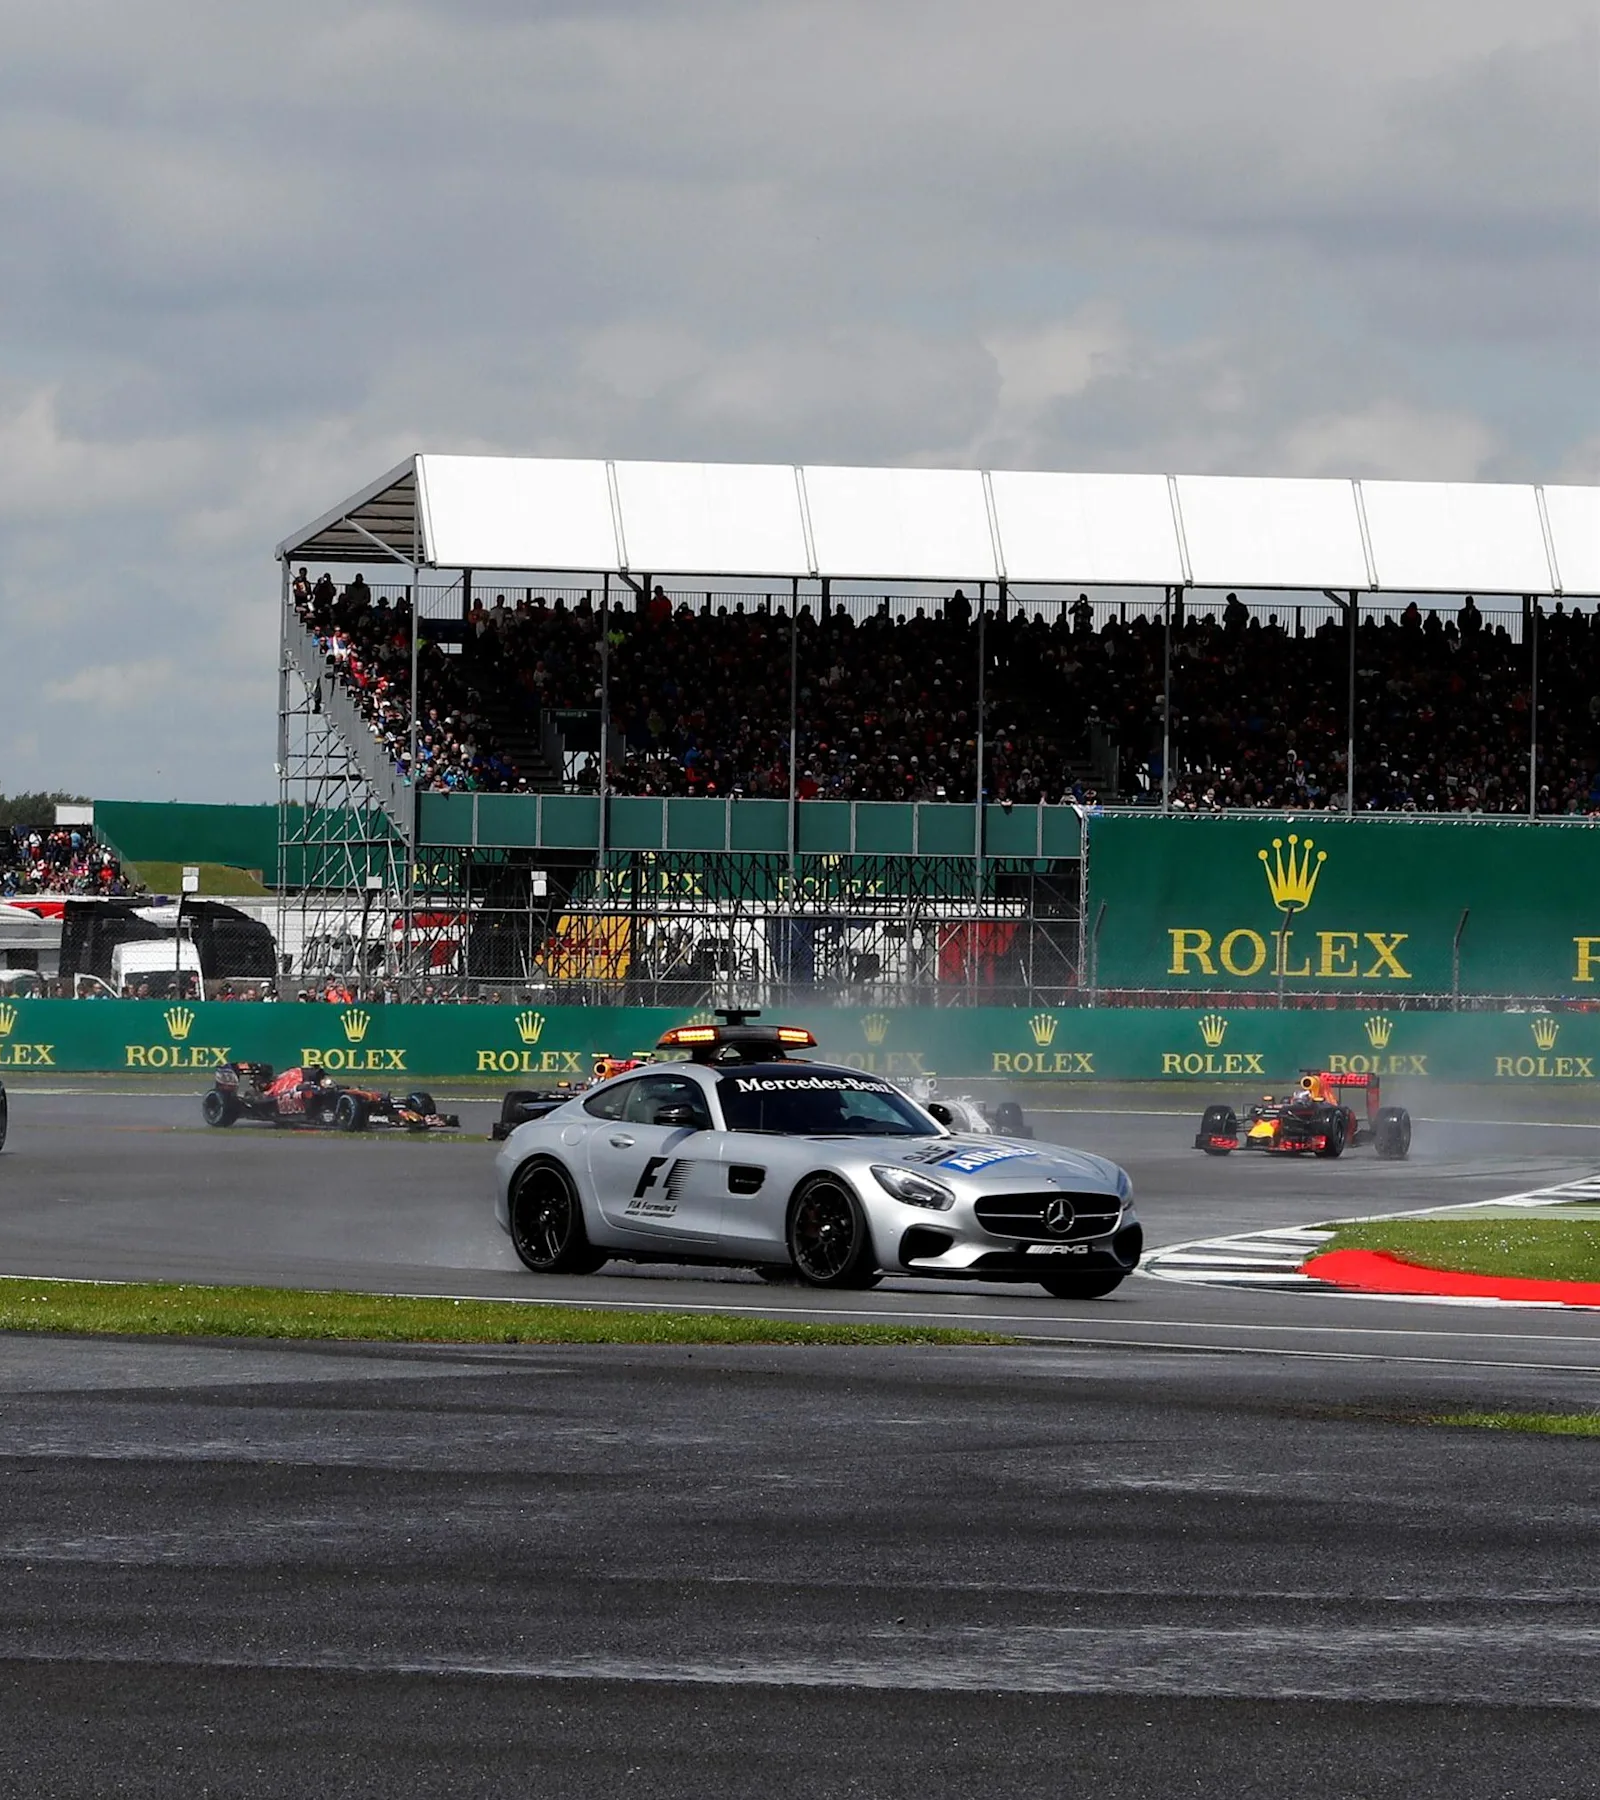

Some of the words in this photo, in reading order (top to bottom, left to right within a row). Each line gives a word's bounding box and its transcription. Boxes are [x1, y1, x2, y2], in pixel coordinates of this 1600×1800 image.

[1167, 928, 1412, 979] ROLEX
[126, 1046, 231, 1067] ROLEX
[301, 1048, 406, 1071] ROLEX
[476, 1050, 582, 1073] ROLEX
[992, 1052, 1094, 1073] ROLEX
[1162, 1053, 1265, 1074] ROLEX
[1329, 1055, 1429, 1076] ROLEX
[1496, 1057, 1594, 1077] ROLEX
[735, 1076, 894, 1095] Mercedes-Benz
[633, 1157, 696, 1201] F1
[628, 1200, 641, 1209] FIA
[642, 1201, 671, 1212] Formula
[1050, 1244, 1088, 1254] AMG
